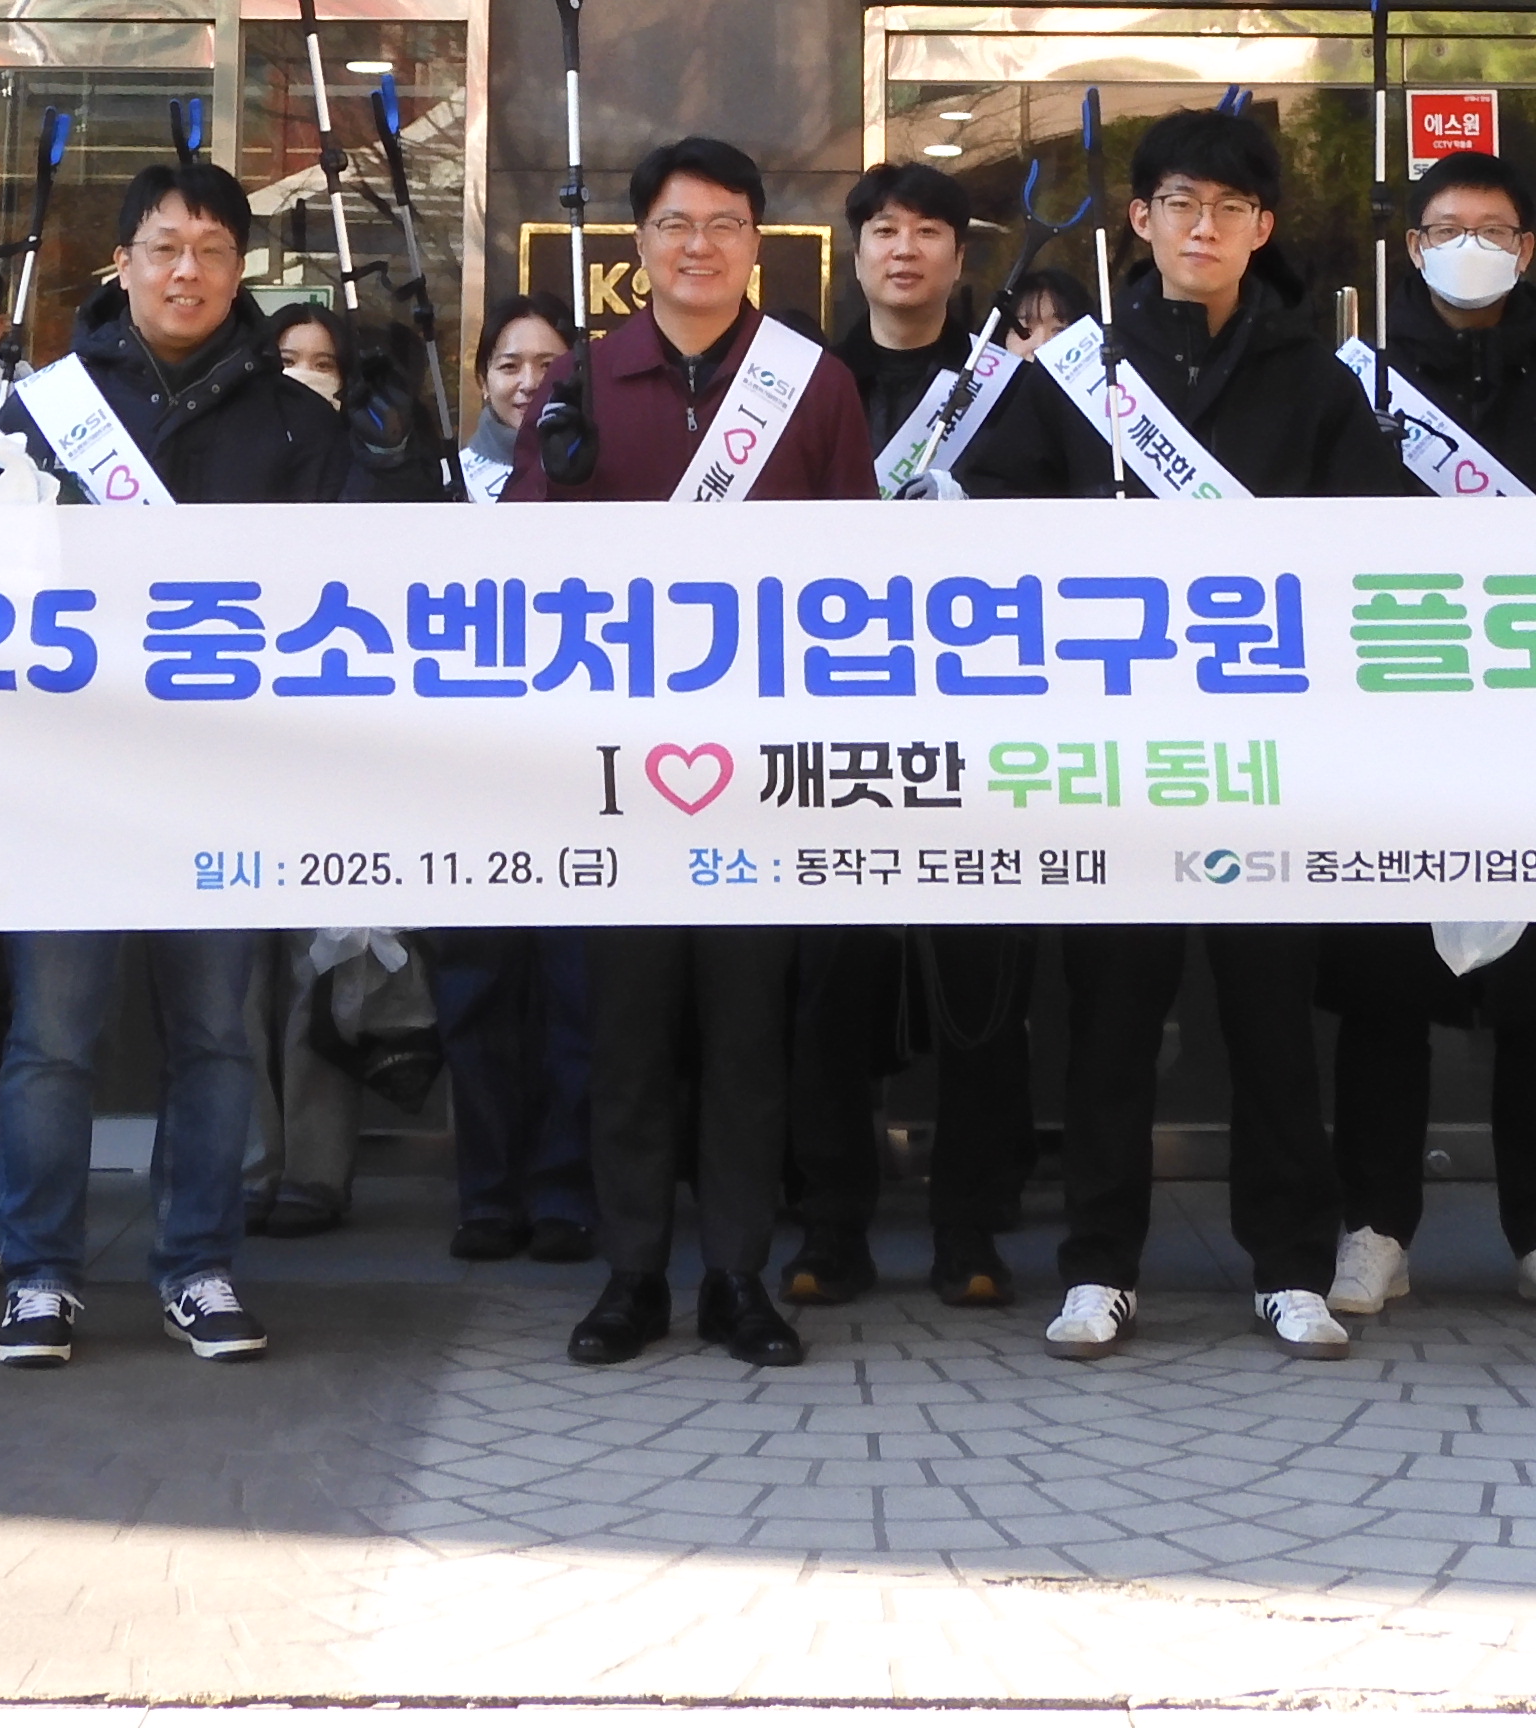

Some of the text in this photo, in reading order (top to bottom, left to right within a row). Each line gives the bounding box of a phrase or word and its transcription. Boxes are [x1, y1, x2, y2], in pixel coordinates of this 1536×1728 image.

[1424, 113, 1480, 136] 에스원
[747, 362, 795, 400] KOSI
[58, 409, 107, 450] KOSI
[1128, 414, 1196, 491] 깨끗한
[142, 573, 1309, 700] 중소벤처기업연구원
[600, 739, 1280, 816] I 깨끗한 우리 동네
[194, 851, 261, 889] 일시
[300, 852, 403, 885] 2025.
[420, 852, 472, 885] 11.
[488, 851, 543, 884] 28.
[559, 847, 618, 888] (금)
[689, 848, 758, 885] 장소
[796, 848, 901, 885] 동작구
[917, 849, 1021, 885] 도림천
[1039, 849, 1106, 885] 일대
[1174, 849, 1290, 884] KOSI
